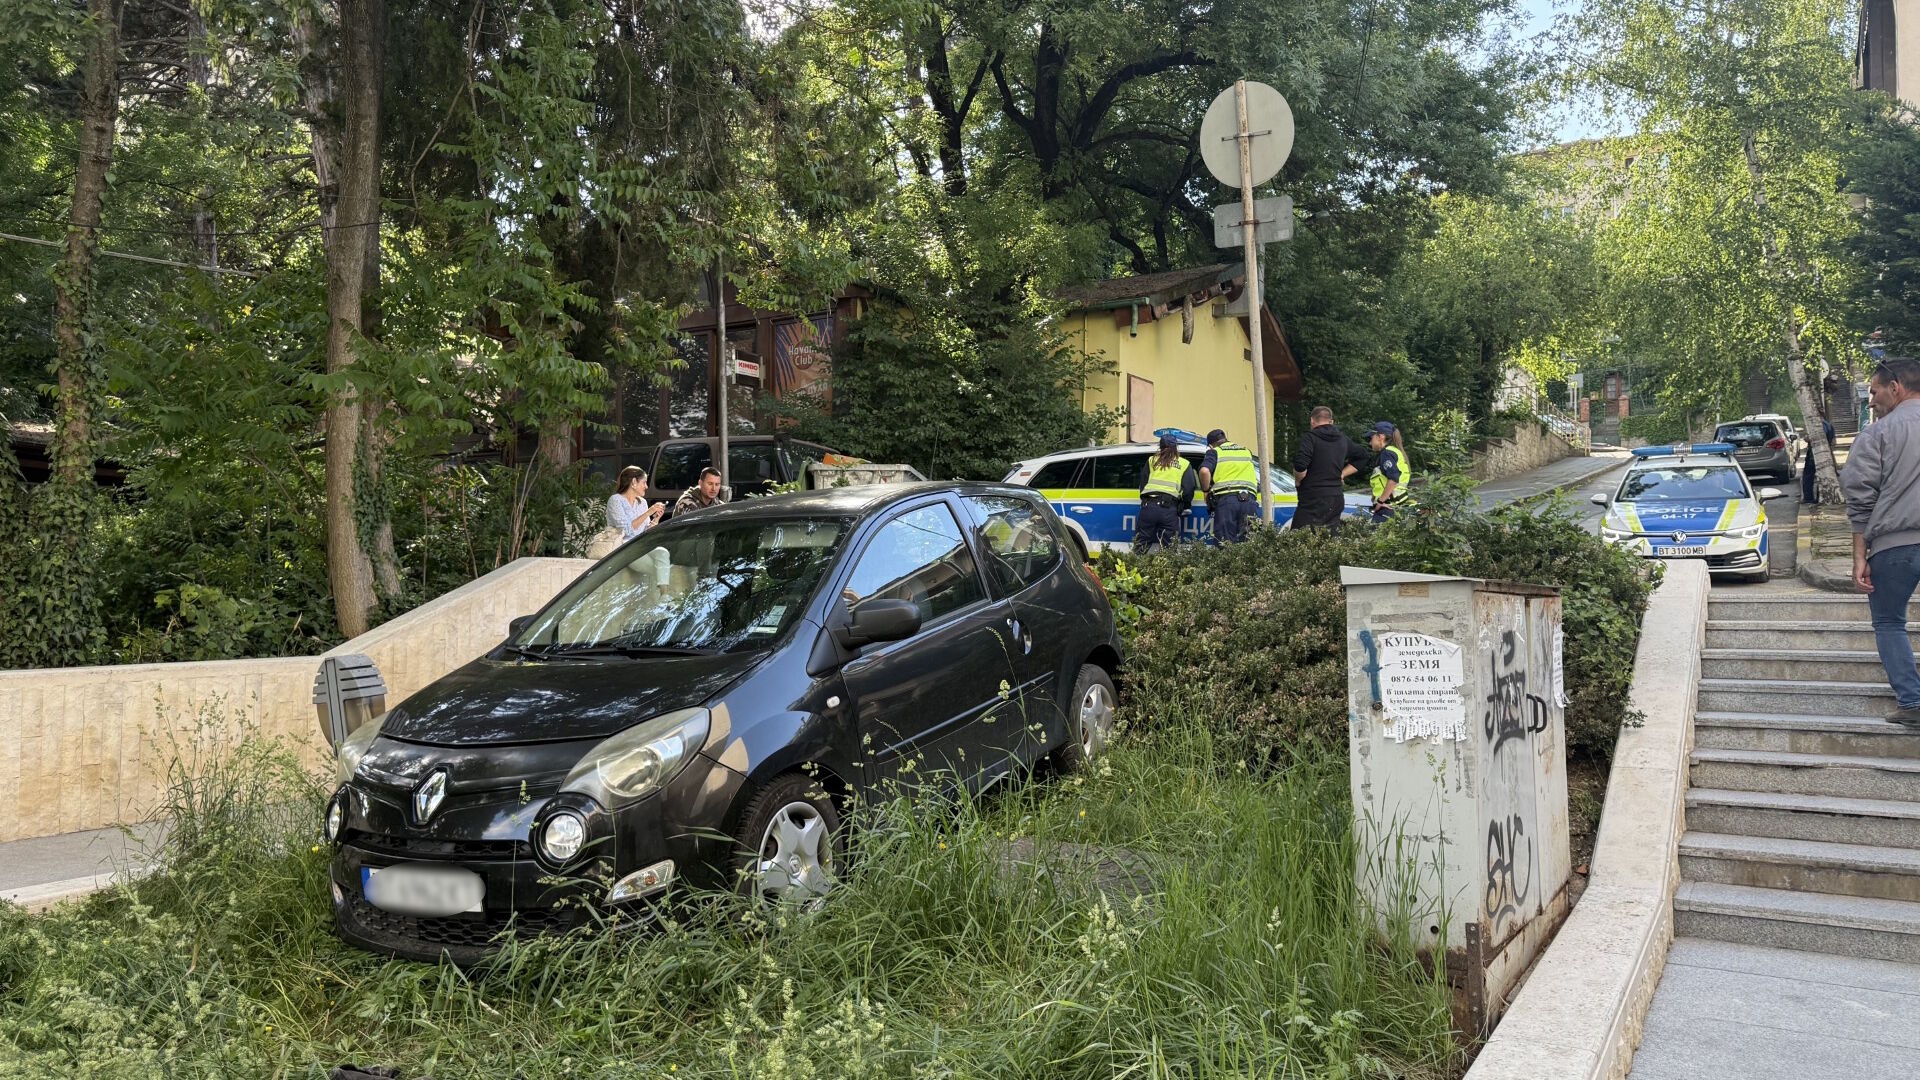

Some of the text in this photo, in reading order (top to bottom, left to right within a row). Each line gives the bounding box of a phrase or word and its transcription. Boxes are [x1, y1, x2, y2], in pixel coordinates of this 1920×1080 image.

[738, 360, 758, 371] KIMBO
[795, 354, 813, 366] Club
[1658, 547, 1704, 555] BT 3100 MB
[1400, 659, 1440, 670] ЗЕМЯ
[1391, 675, 1452, 683] 0876 54 06 11
